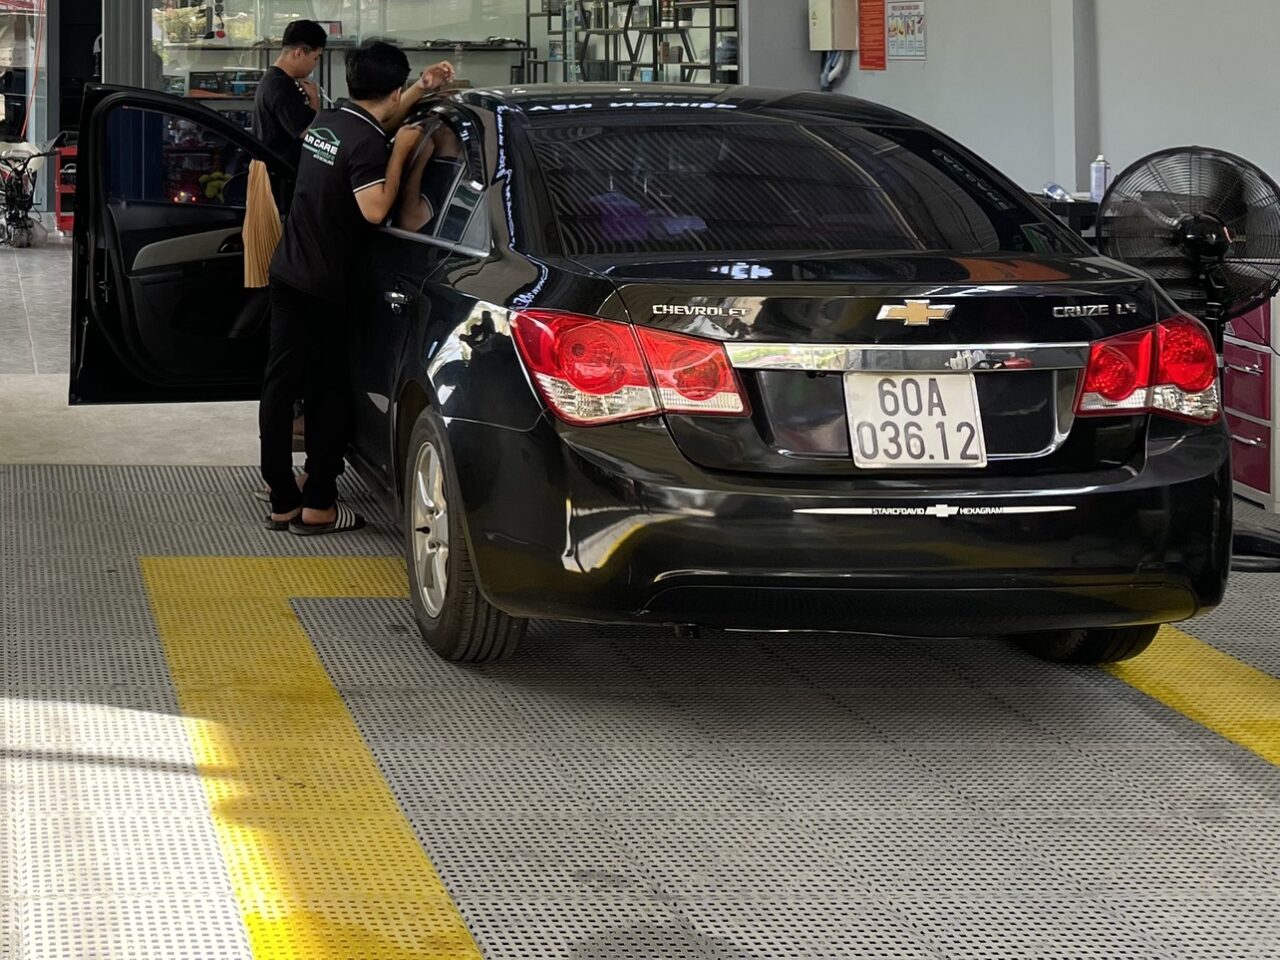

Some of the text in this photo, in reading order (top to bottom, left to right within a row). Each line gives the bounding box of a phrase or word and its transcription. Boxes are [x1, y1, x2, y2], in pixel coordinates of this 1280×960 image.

[303, 133, 315, 145] AR
[314, 138, 339, 156] CARE
[652, 304, 751, 317] CHEVROLET
[1052, 304, 1110, 318] CRUZE
[877, 377, 947, 417] 60A
[856, 420, 980, 460] 036.12
[959, 506, 1004, 515] HEXAGRAM
